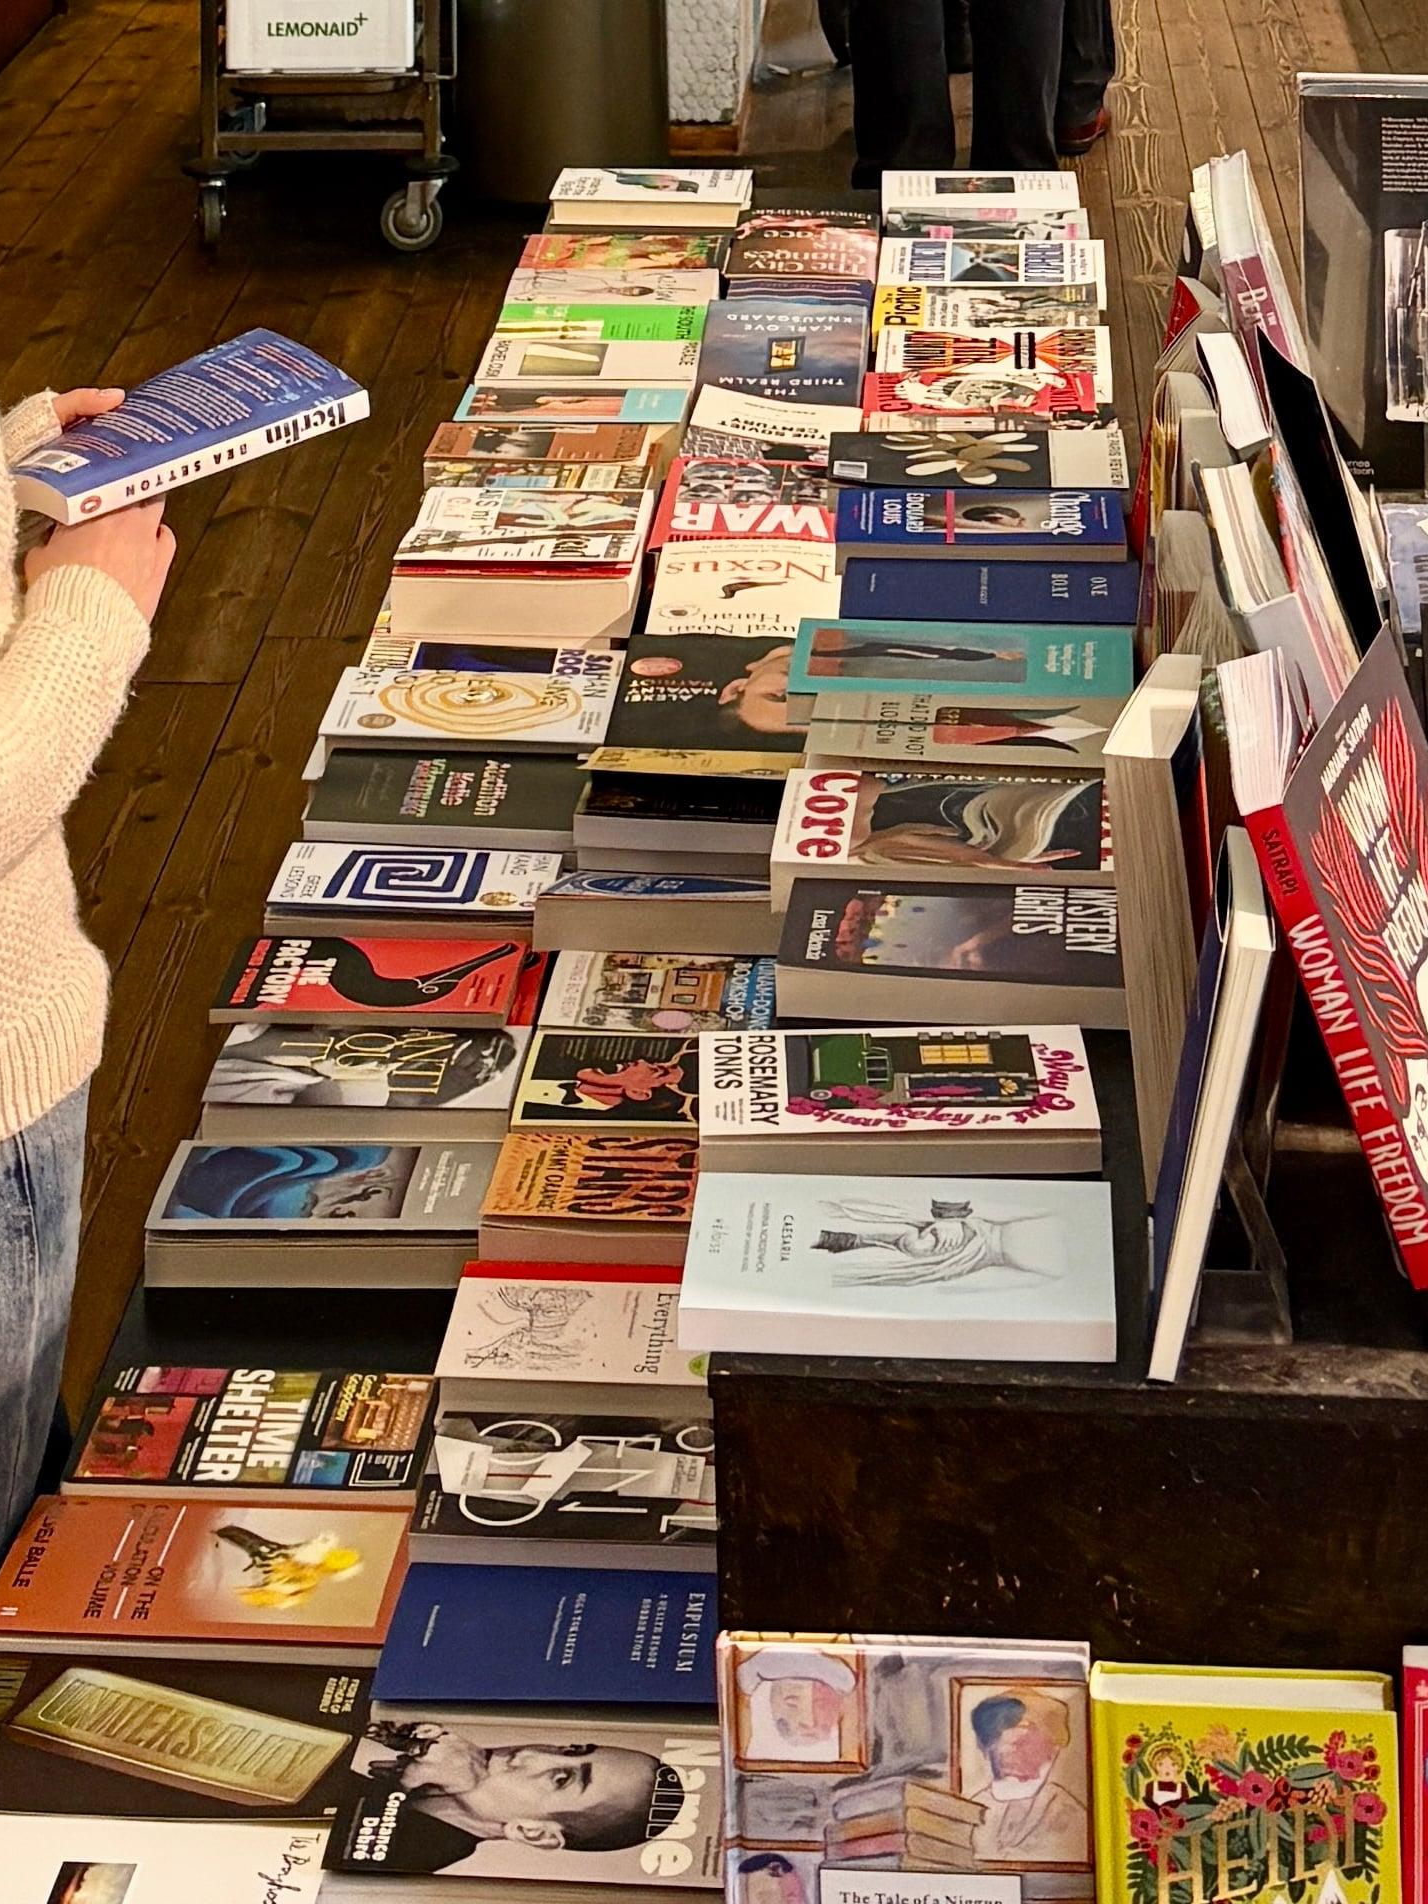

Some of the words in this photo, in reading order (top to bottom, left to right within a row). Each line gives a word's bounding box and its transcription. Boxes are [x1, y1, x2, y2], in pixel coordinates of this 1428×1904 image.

[884, 285, 923, 326] Picnic
[212, 443, 248, 465] BEA
[265, 401, 347, 446] Berlin
[125, 460, 201, 498] SETTON
[671, 502, 830, 539] WAR
[881, 497, 903, 526] LOUIS
[664, 559, 832, 584] Nexus
[796, 771, 862, 858] Core
[1338, 744, 1390, 857] WOMAN
[1369, 826, 1403, 907] LIFE
[1012, 886, 1065, 935] LIGHTS
[1065, 887, 1118, 955] MYSTERY
[258, 939, 312, 1005] FACTORY
[298, 958, 336, 987] THE
[725, 961, 753, 1020] BOOKSHOP
[1261, 827, 1302, 897] SATRAPI
[1287, 912, 1358, 1035] WOMAN
[1334, 1046, 1383, 1119] LIFE
[714, 1037, 742, 1090] TONKS
[747, 1034, 780, 1126] ROSEMARY
[780, 1214, 795, 1262] CAESARIA
[634, 1291, 682, 1376] Everything
[192, 1368, 276, 1483] SHELTER
[244, 1398, 309, 1470] TIME
[673, 1592, 707, 1675] EMPUSIUM
[351, 1815, 381, 1863] Debré
[374, 1791, 408, 1864] Constance
[1155, 1790, 1362, 1904] HEIDI
